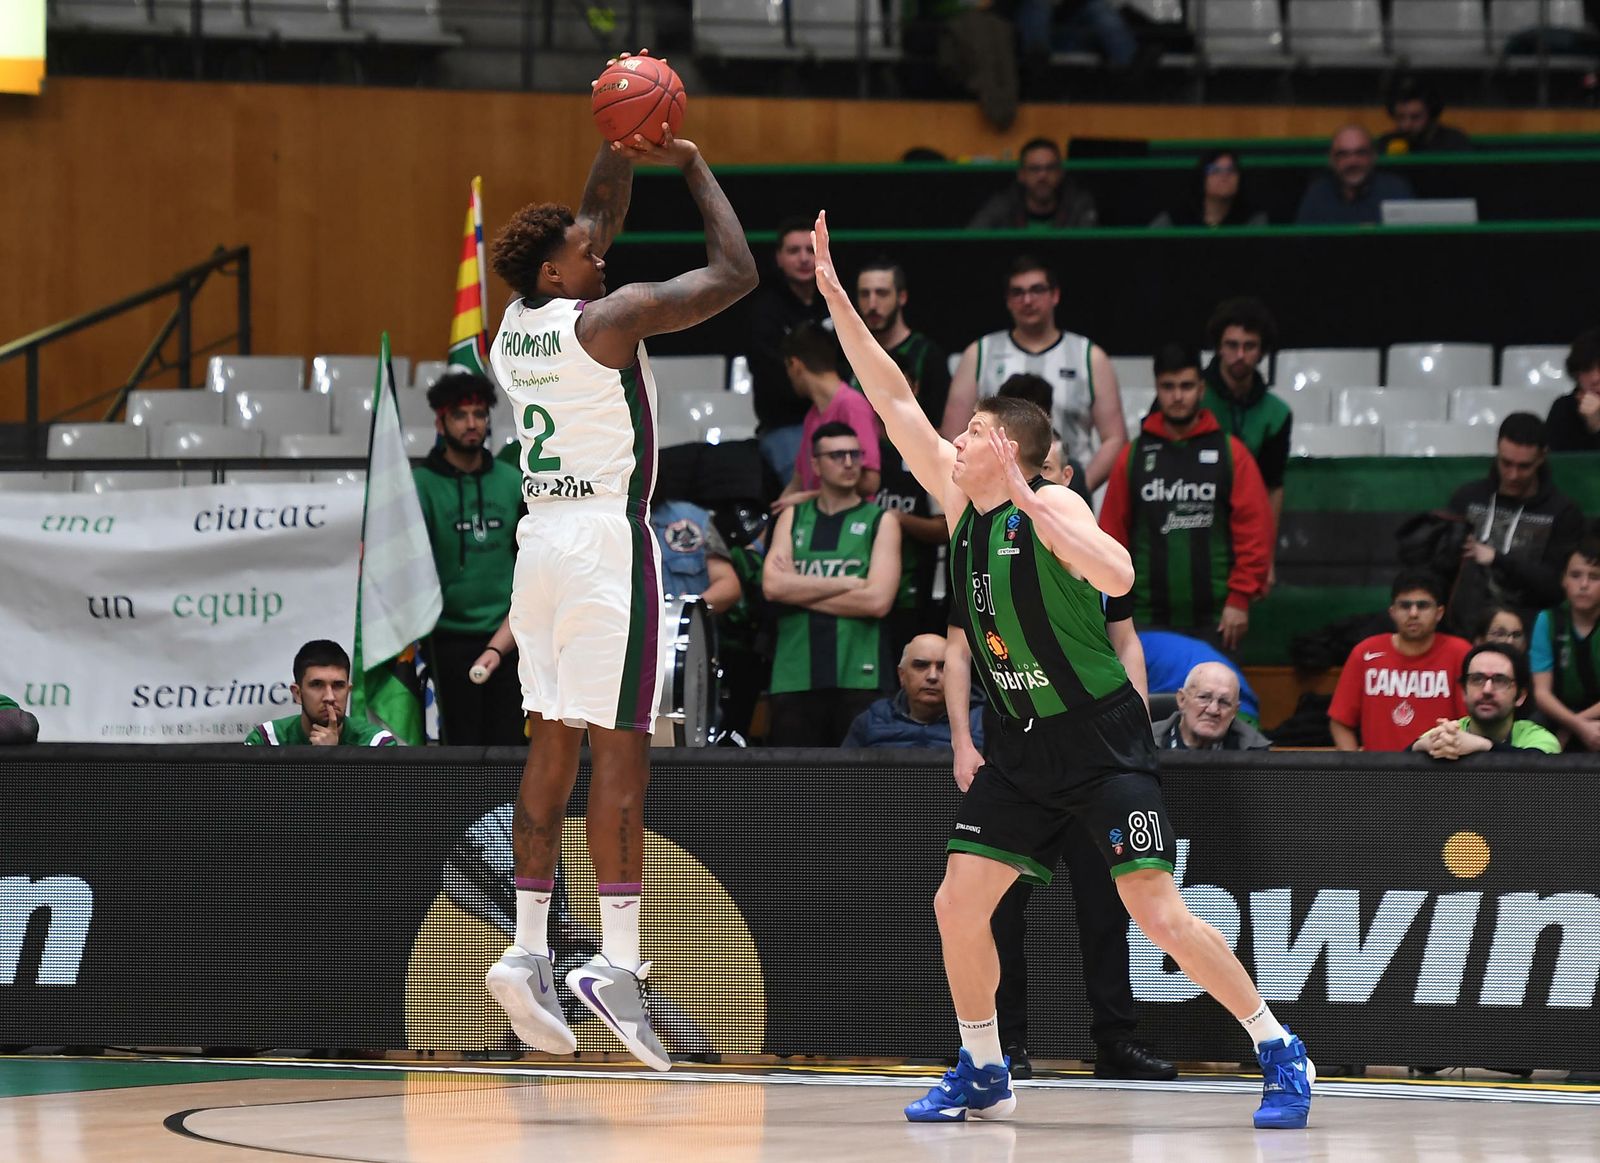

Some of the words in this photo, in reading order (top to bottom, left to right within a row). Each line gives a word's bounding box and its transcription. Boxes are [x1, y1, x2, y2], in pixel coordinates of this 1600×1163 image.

[523, 404, 561, 473] 2
[1141, 478, 1217, 502] divina
[41, 514, 116, 534] una
[194, 503, 327, 532] ciutat
[87, 594, 135, 619] un
[172, 587, 283, 625] equip
[972, 571, 996, 616] 81
[23, 681, 71, 707] un
[131, 679, 301, 709] sentime
[1365, 668, 1450, 698] CANADA
[955, 822, 981, 834] SPALDING
[1128, 811, 1164, 852] 81
[1126, 838, 1600, 1009] bwin
